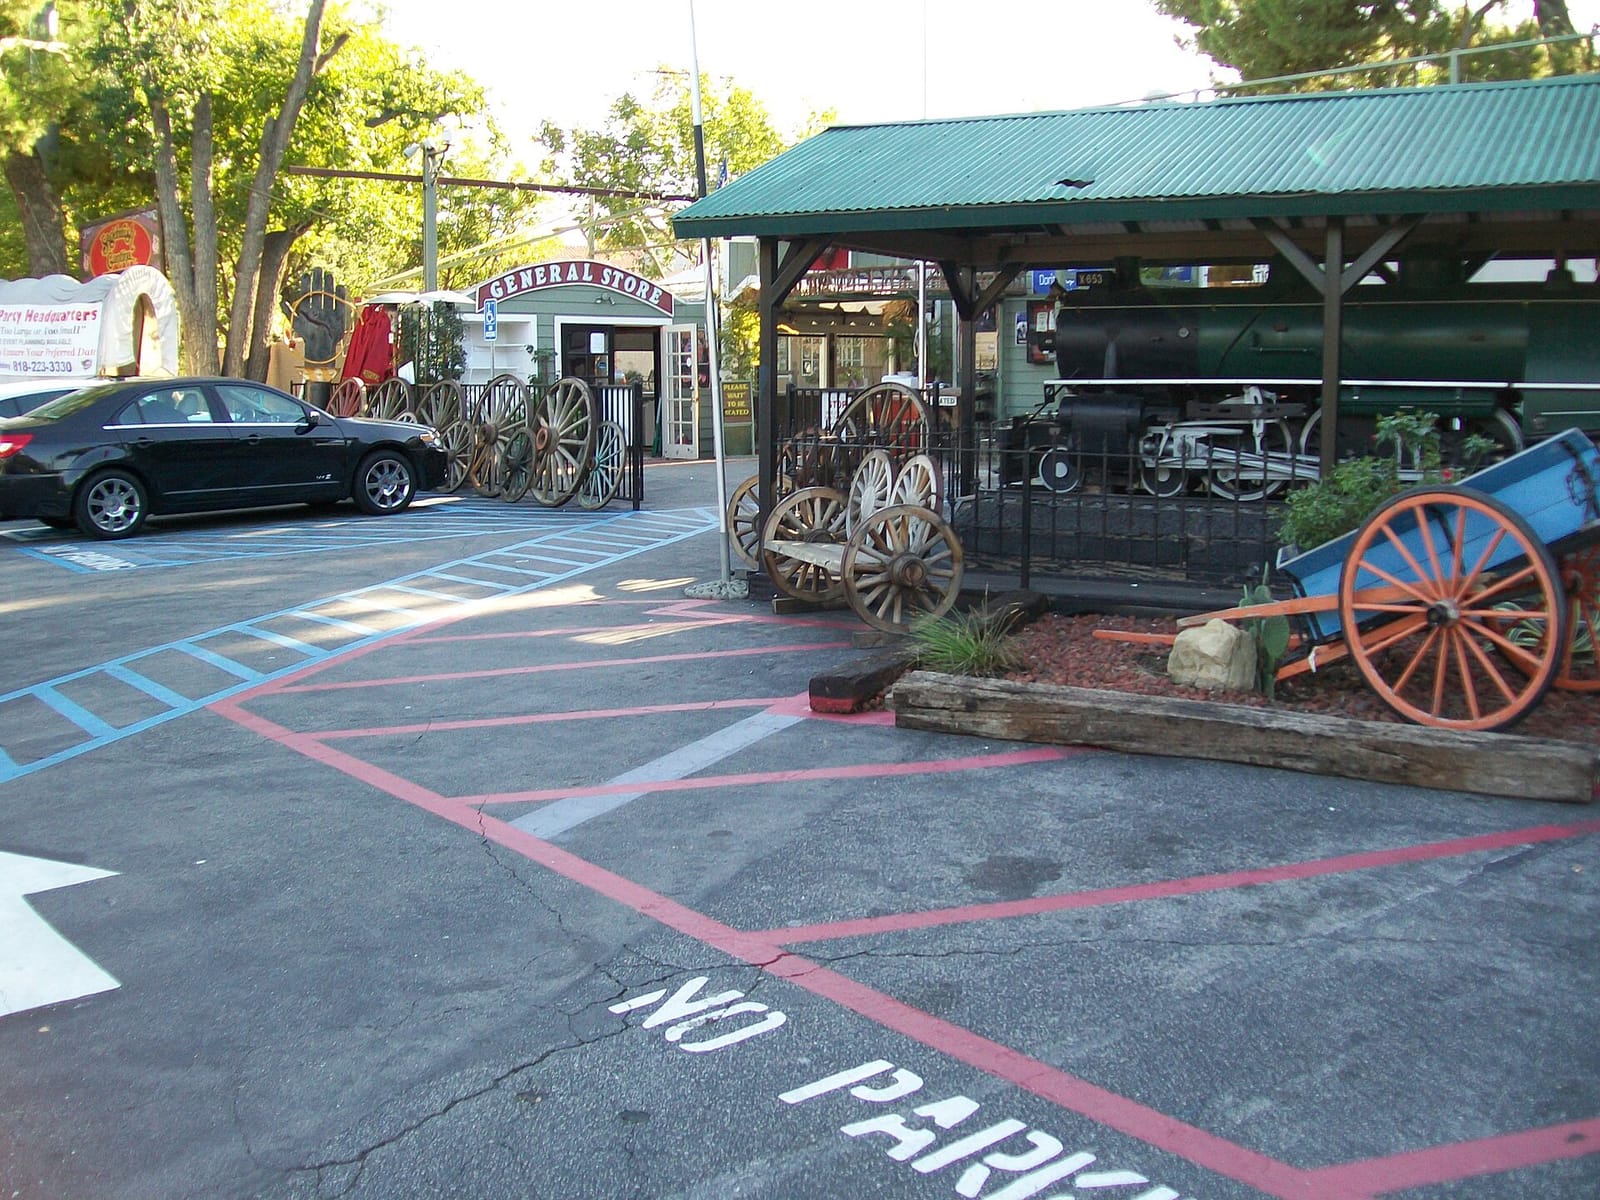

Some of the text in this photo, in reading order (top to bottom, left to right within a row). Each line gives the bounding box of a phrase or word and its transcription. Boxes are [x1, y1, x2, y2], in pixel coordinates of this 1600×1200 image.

[490, 263, 662, 304] GENERAL STORE
[25, 308, 98, 323] Headquarters
[13, 360, 72, 372] 818-223-3330
[727, 391, 744, 399] WAIT
[607, 975, 787, 1054] NO
[777, 1058, 1190, 1200] PARK
